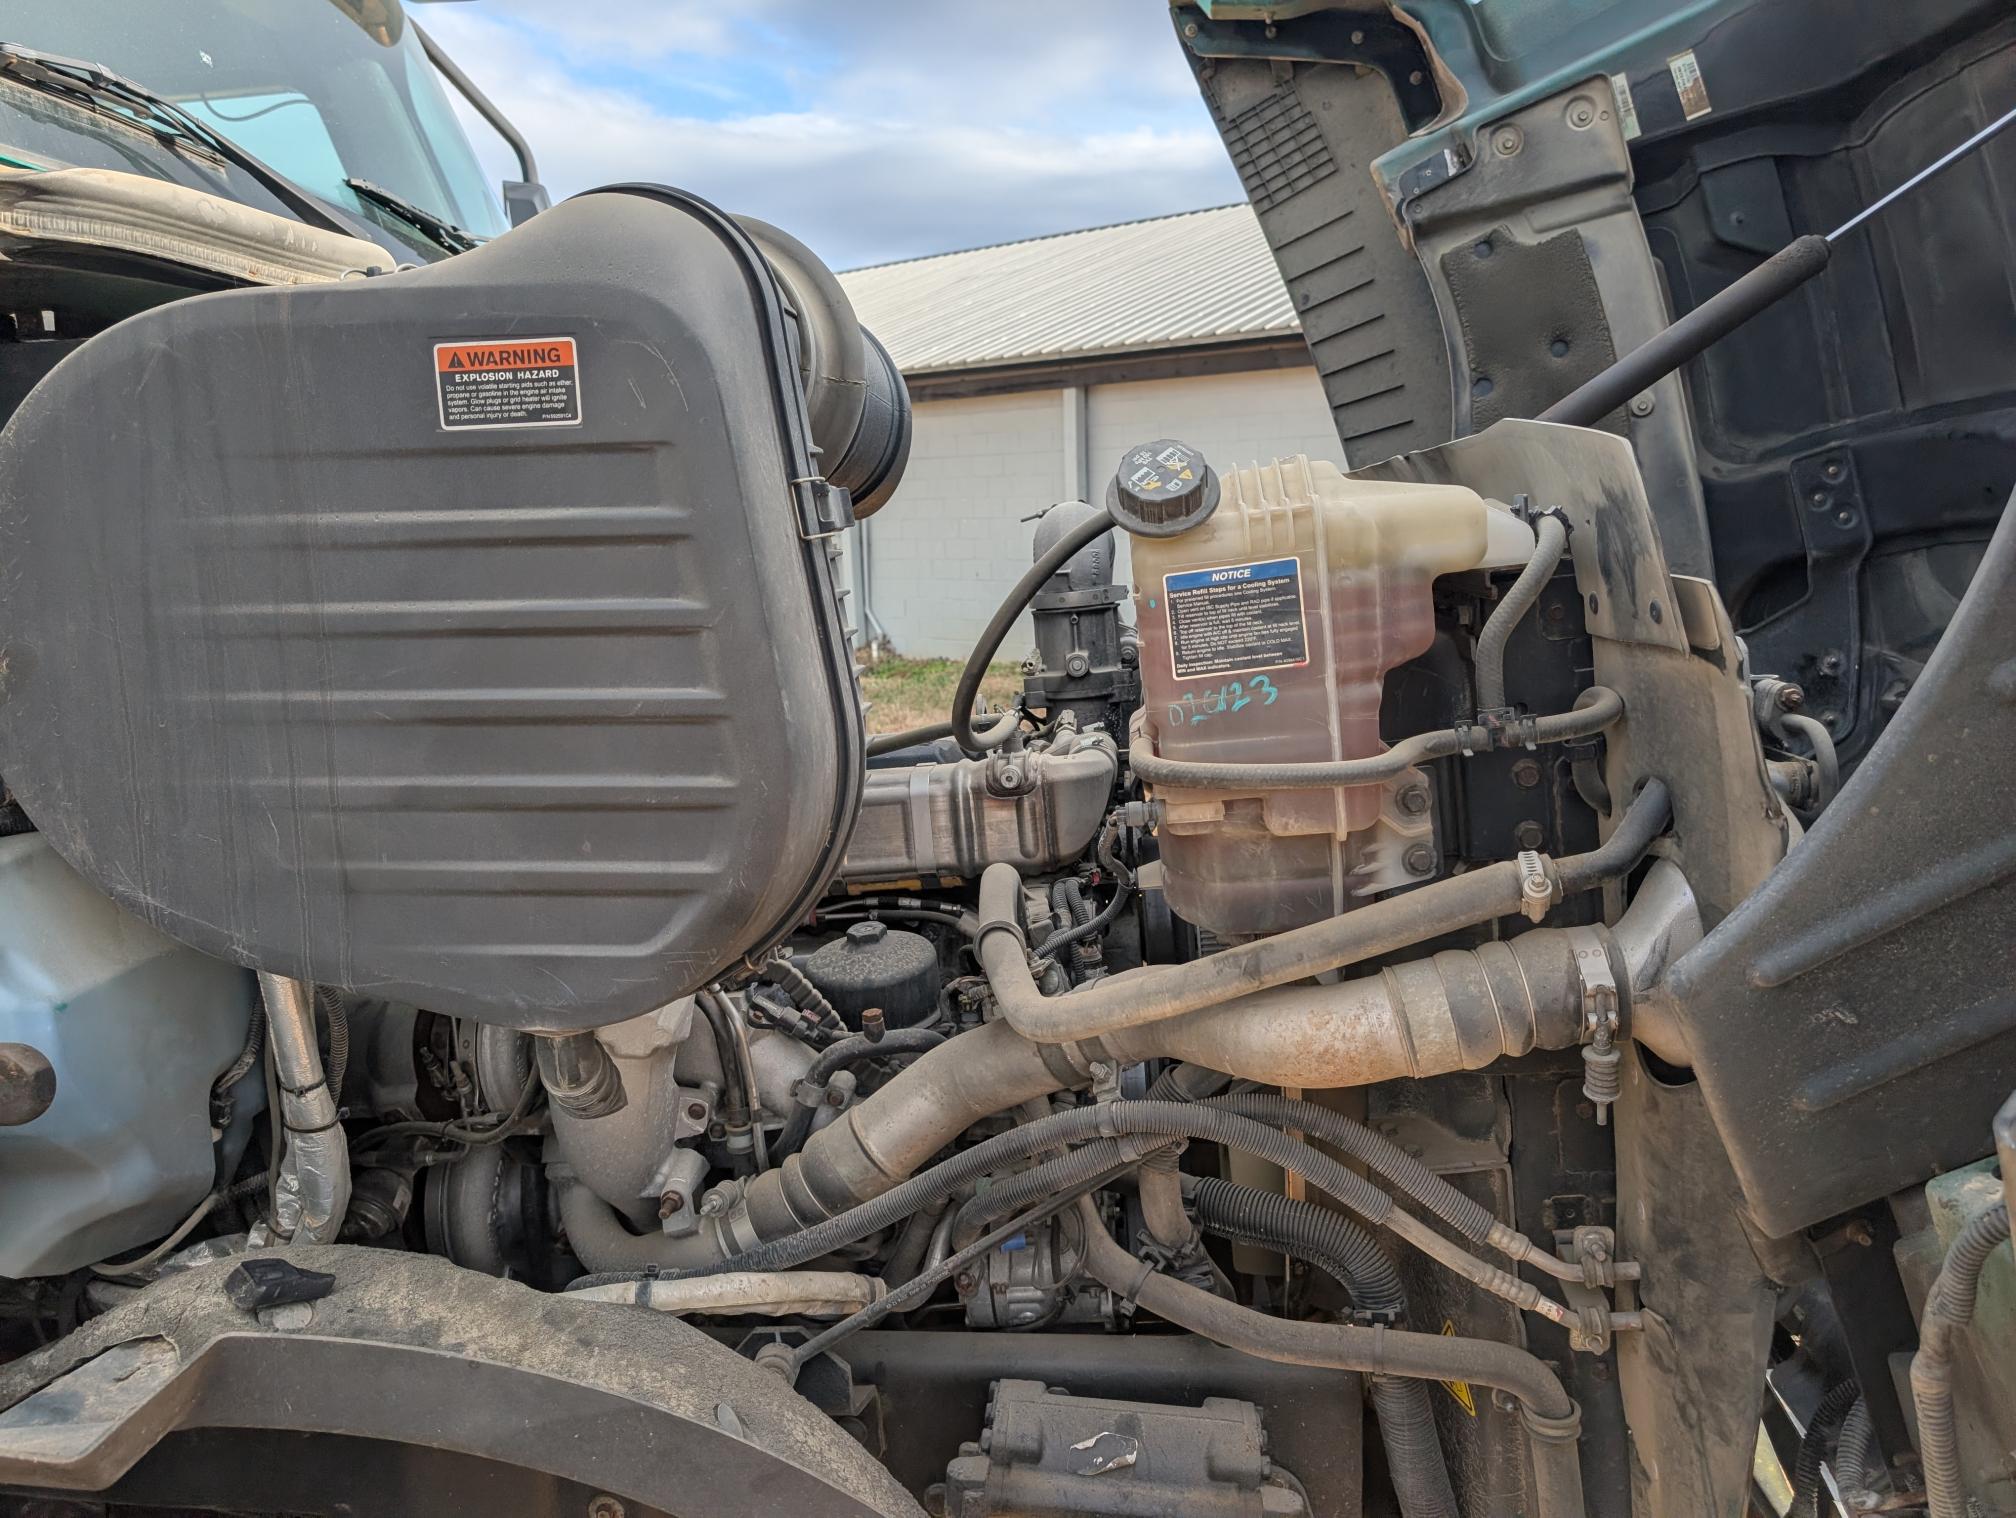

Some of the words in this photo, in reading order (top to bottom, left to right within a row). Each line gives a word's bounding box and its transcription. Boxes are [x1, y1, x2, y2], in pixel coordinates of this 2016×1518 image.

[467, 347, 561, 368] WARNING
[455, 372, 512, 383] EXPLOSION
[518, 370, 559, 379] HAZARD
[499, 382, 520, 390] starting
[479, 390, 502, 398] gasoline
[542, 402, 565, 410] damage
[1212, 568, 1252, 582] NOTICE
[1170, 590, 1191, 598] Service
[1209, 586, 1226, 594] Steps
[1242, 580, 1266, 590] Cooling
[1267, 577, 1290, 586] System
